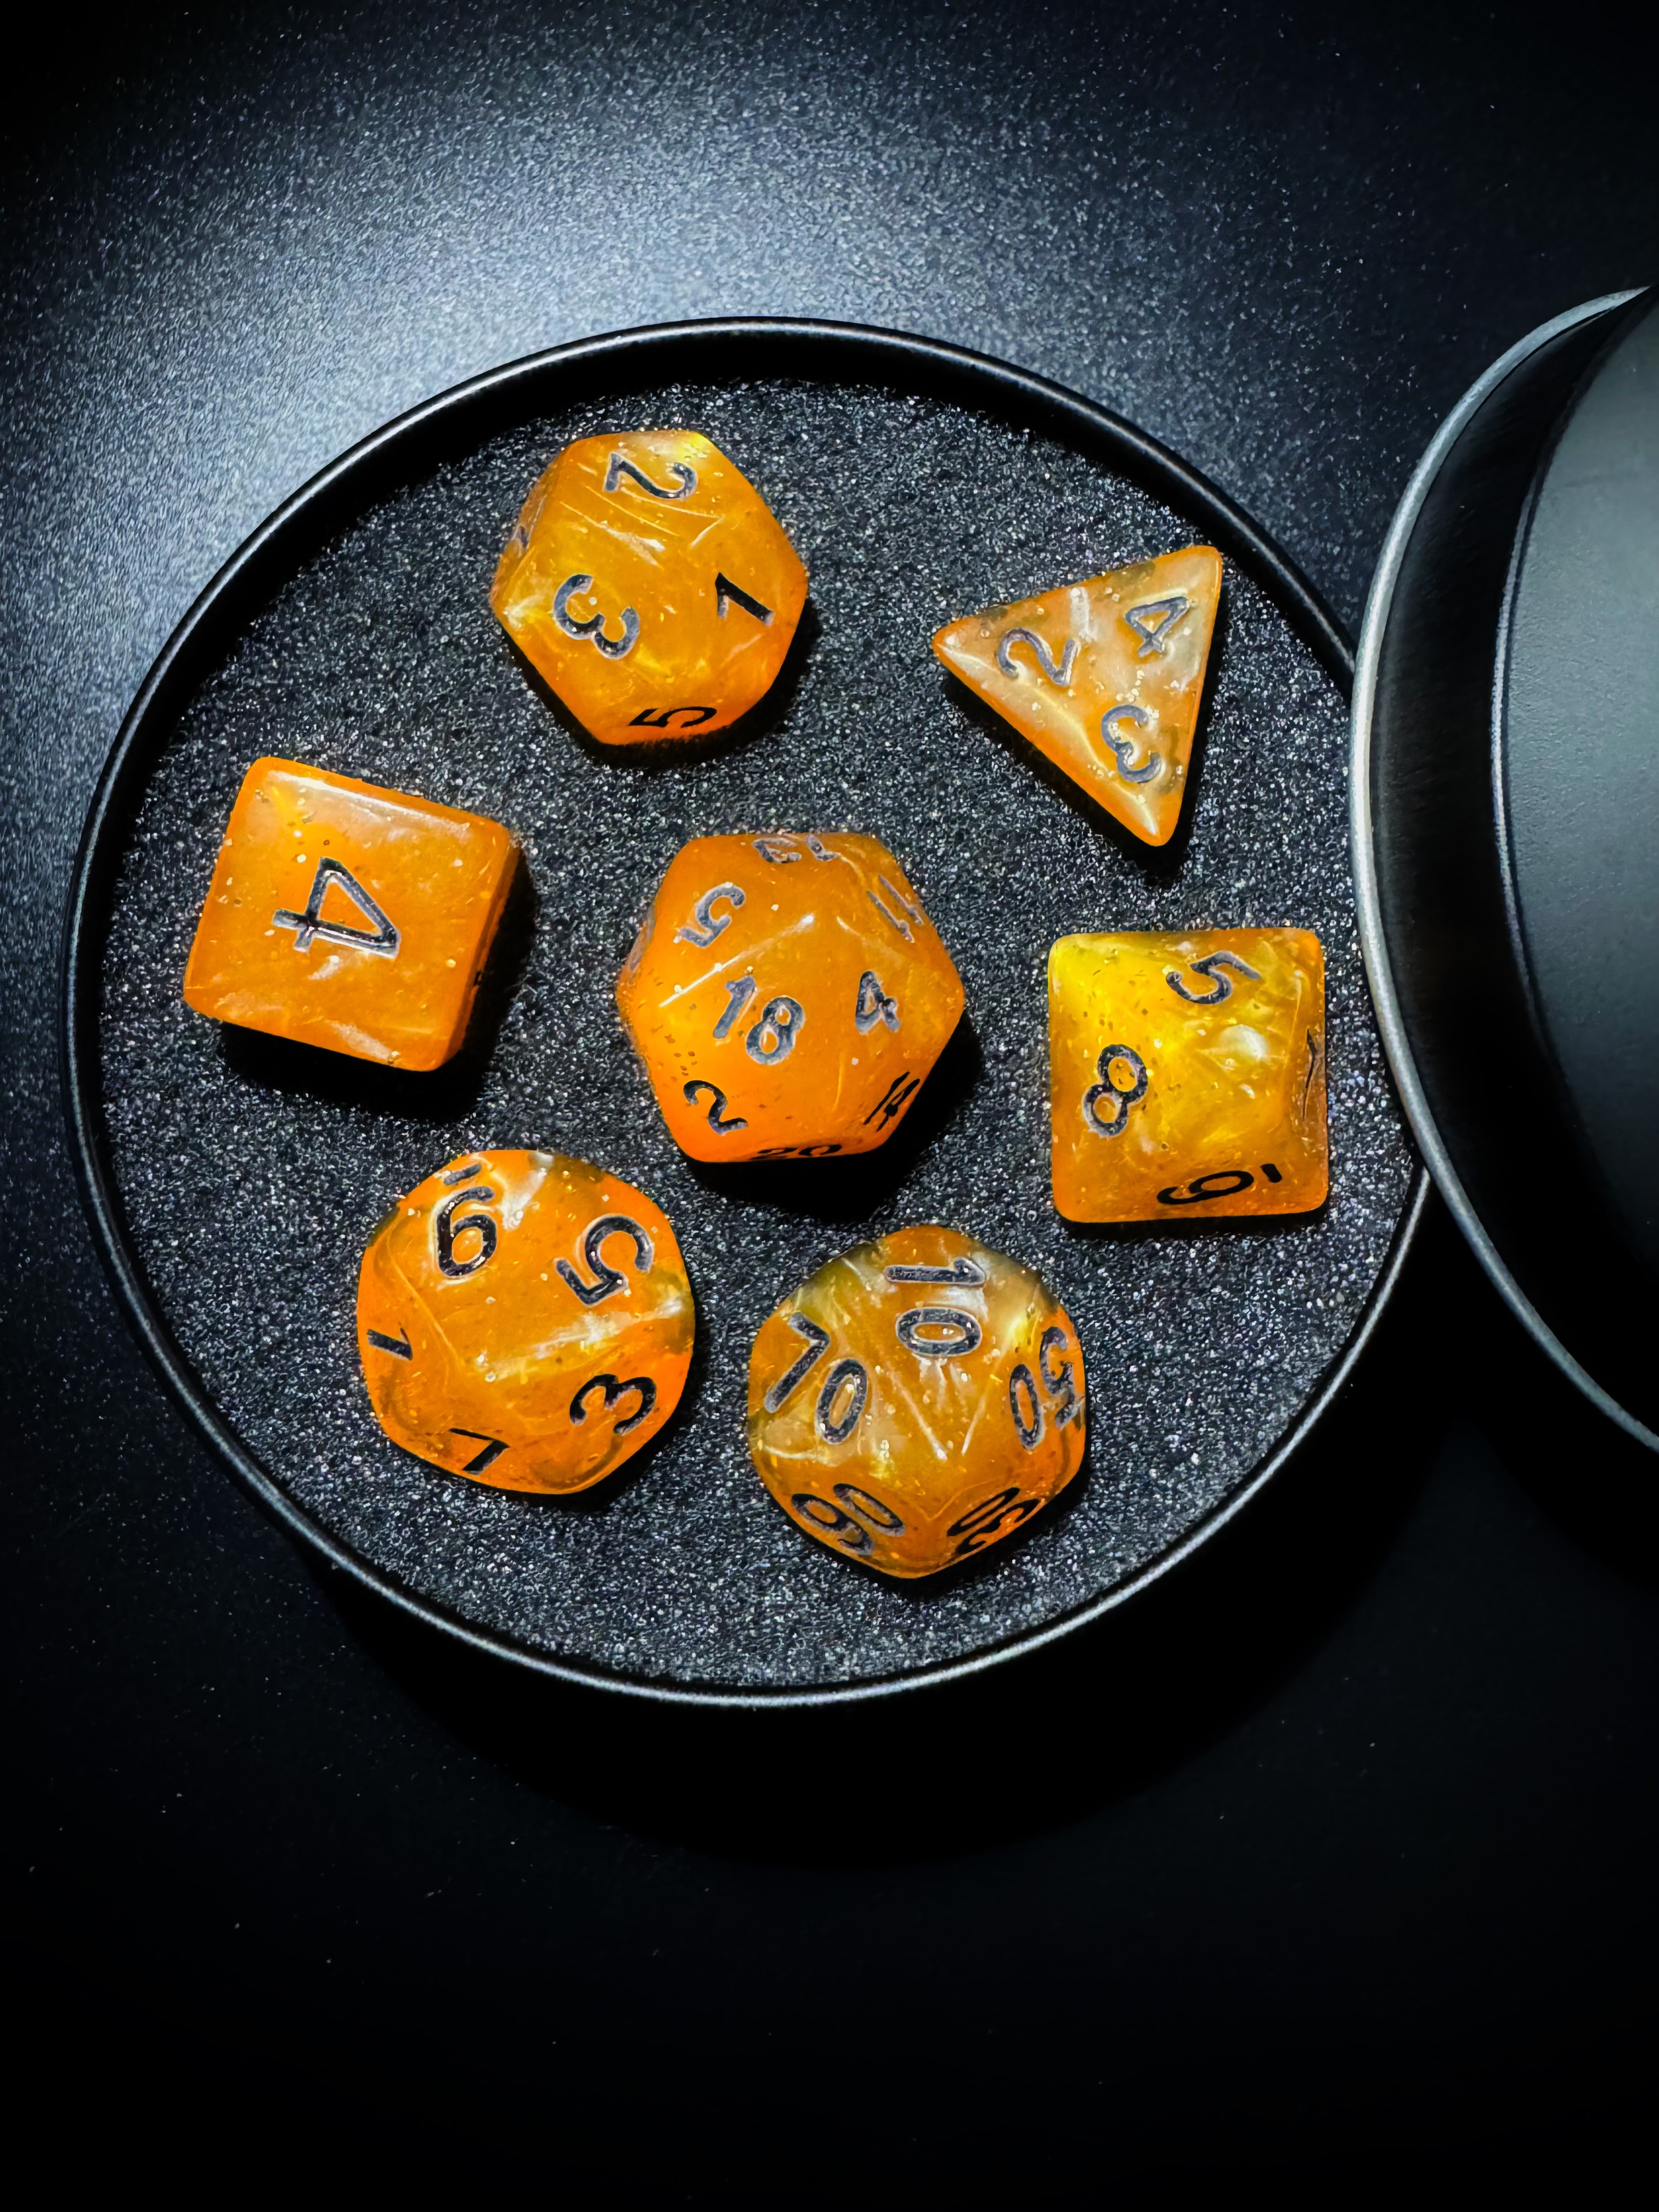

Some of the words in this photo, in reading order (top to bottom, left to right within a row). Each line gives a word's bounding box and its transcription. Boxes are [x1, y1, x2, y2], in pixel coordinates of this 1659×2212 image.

[603, 453, 698, 500] 2
[554, 573, 640, 659] 3
[715, 572, 775, 627] 1
[1126, 596, 1192, 658] 4
[997, 628, 1081, 687] 2
[629, 706, 718, 728] 5
[1101, 704, 1164, 783] 3
[272, 856, 401, 959] 4
[673, 882, 746, 948] 5
[855, 971, 901, 1035] 4
[1166, 950, 1261, 1005] 5
[713, 975, 805, 1065] 18
[684, 1080, 748, 1136] 2
[1082, 1044, 1148, 1138] 8
[555, 1214, 654, 1307] 5
[884, 1257, 985, 1357] 10
[569, 1374, 657, 1436] 3
[764, 1312, 867, 1445] 70
[1009, 1327, 1081, 1451] 50
